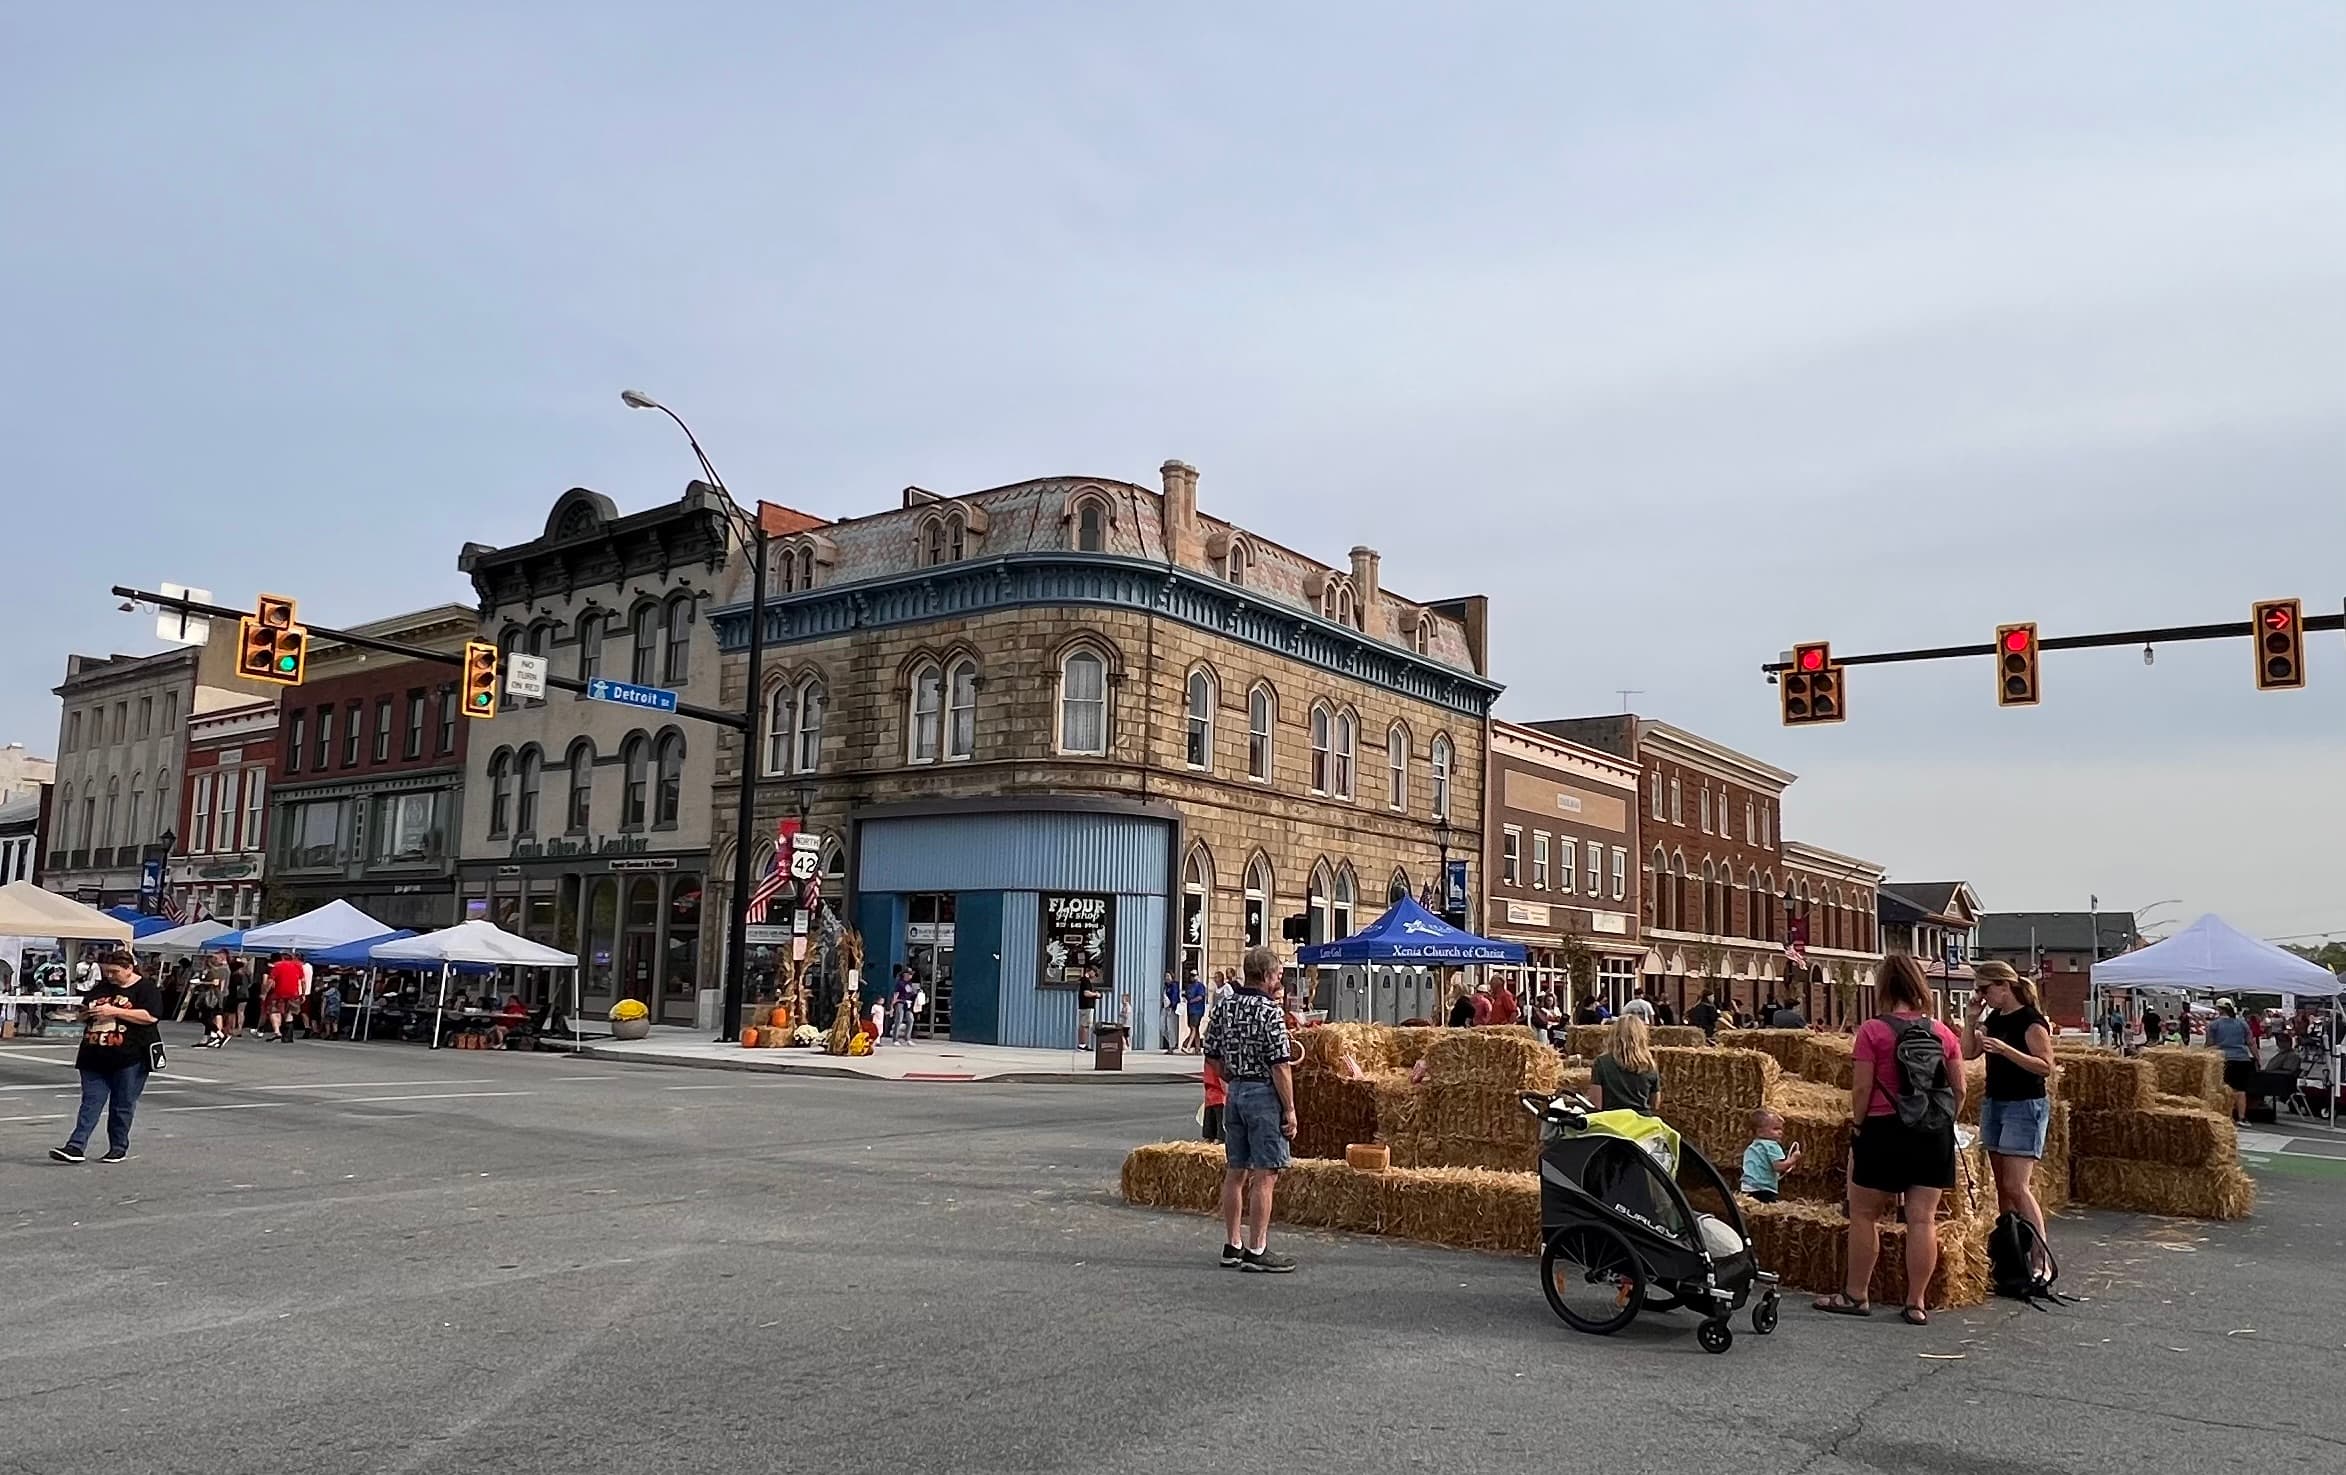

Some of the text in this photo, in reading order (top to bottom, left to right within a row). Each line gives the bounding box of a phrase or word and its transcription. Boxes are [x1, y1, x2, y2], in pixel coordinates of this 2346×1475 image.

[521, 661, 535, 670] NO
[517, 671, 537, 681] TURN
[511, 681, 541, 693] ON RED
[613, 686, 657, 705] Detroit
[598, 832, 649, 854] Leather
[795, 837, 819, 847] NORTH
[794, 856, 816, 873] 42
[1048, 897, 1106, 914] FLOUR
[1392, 944, 1506, 959] Xenia Church of Christ
[1614, 1203, 1679, 1239] BURLEY
